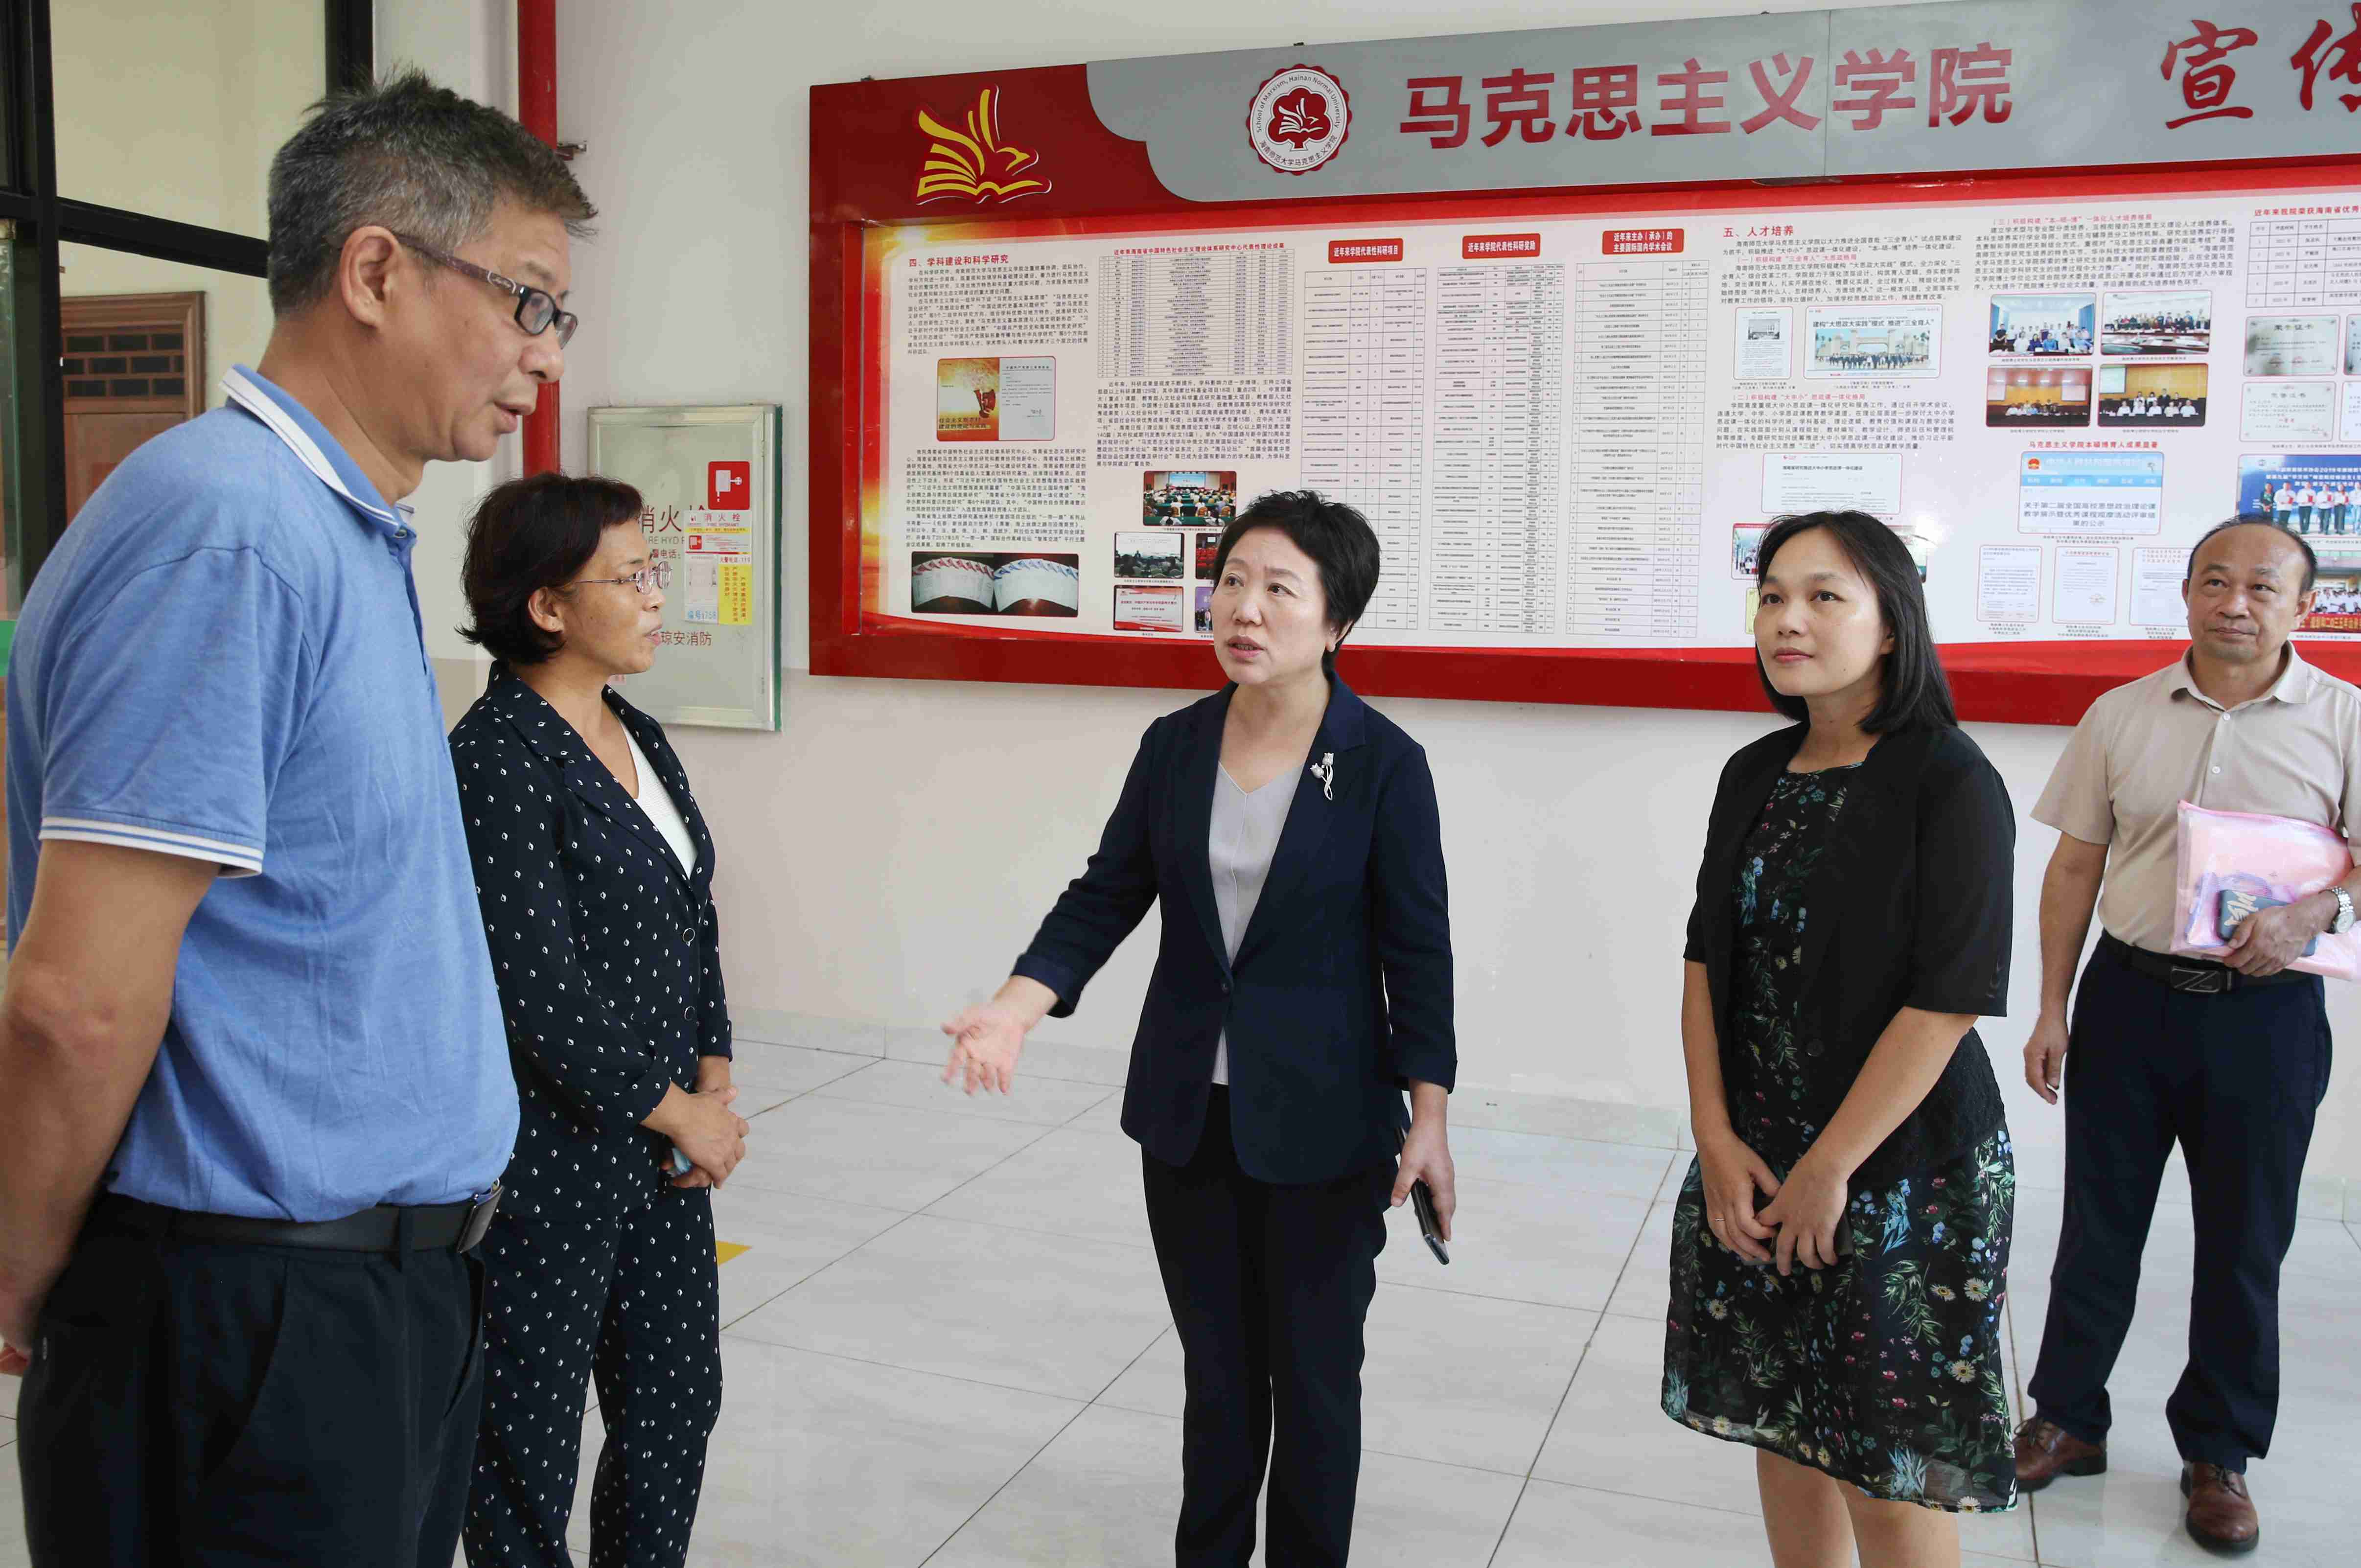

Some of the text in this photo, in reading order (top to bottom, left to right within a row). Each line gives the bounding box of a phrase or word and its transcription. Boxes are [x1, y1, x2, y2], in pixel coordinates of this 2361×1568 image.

[1400, 43, 2013, 149] 马克思主义学院
[1260, 101, 1265, 109] of
[1313, 77, 1332, 96] Normal
[1331, 93, 1343, 130] University
[1259, 135, 1338, 166] 海南师范大学马克思主义学院
[1723, 226, 1794, 237] 五、人才培养
[1334, 245, 1398, 257] 近年来学院代表性科研项目
[1468, 240, 1535, 253] 近年来学院代表性科研奖励
[1613, 242, 1672, 253] 主要国际国内学术会议
[909, 254, 1009, 267] 四、学科建设和科学研究
[705, 513, 741, 522] 消火栓
